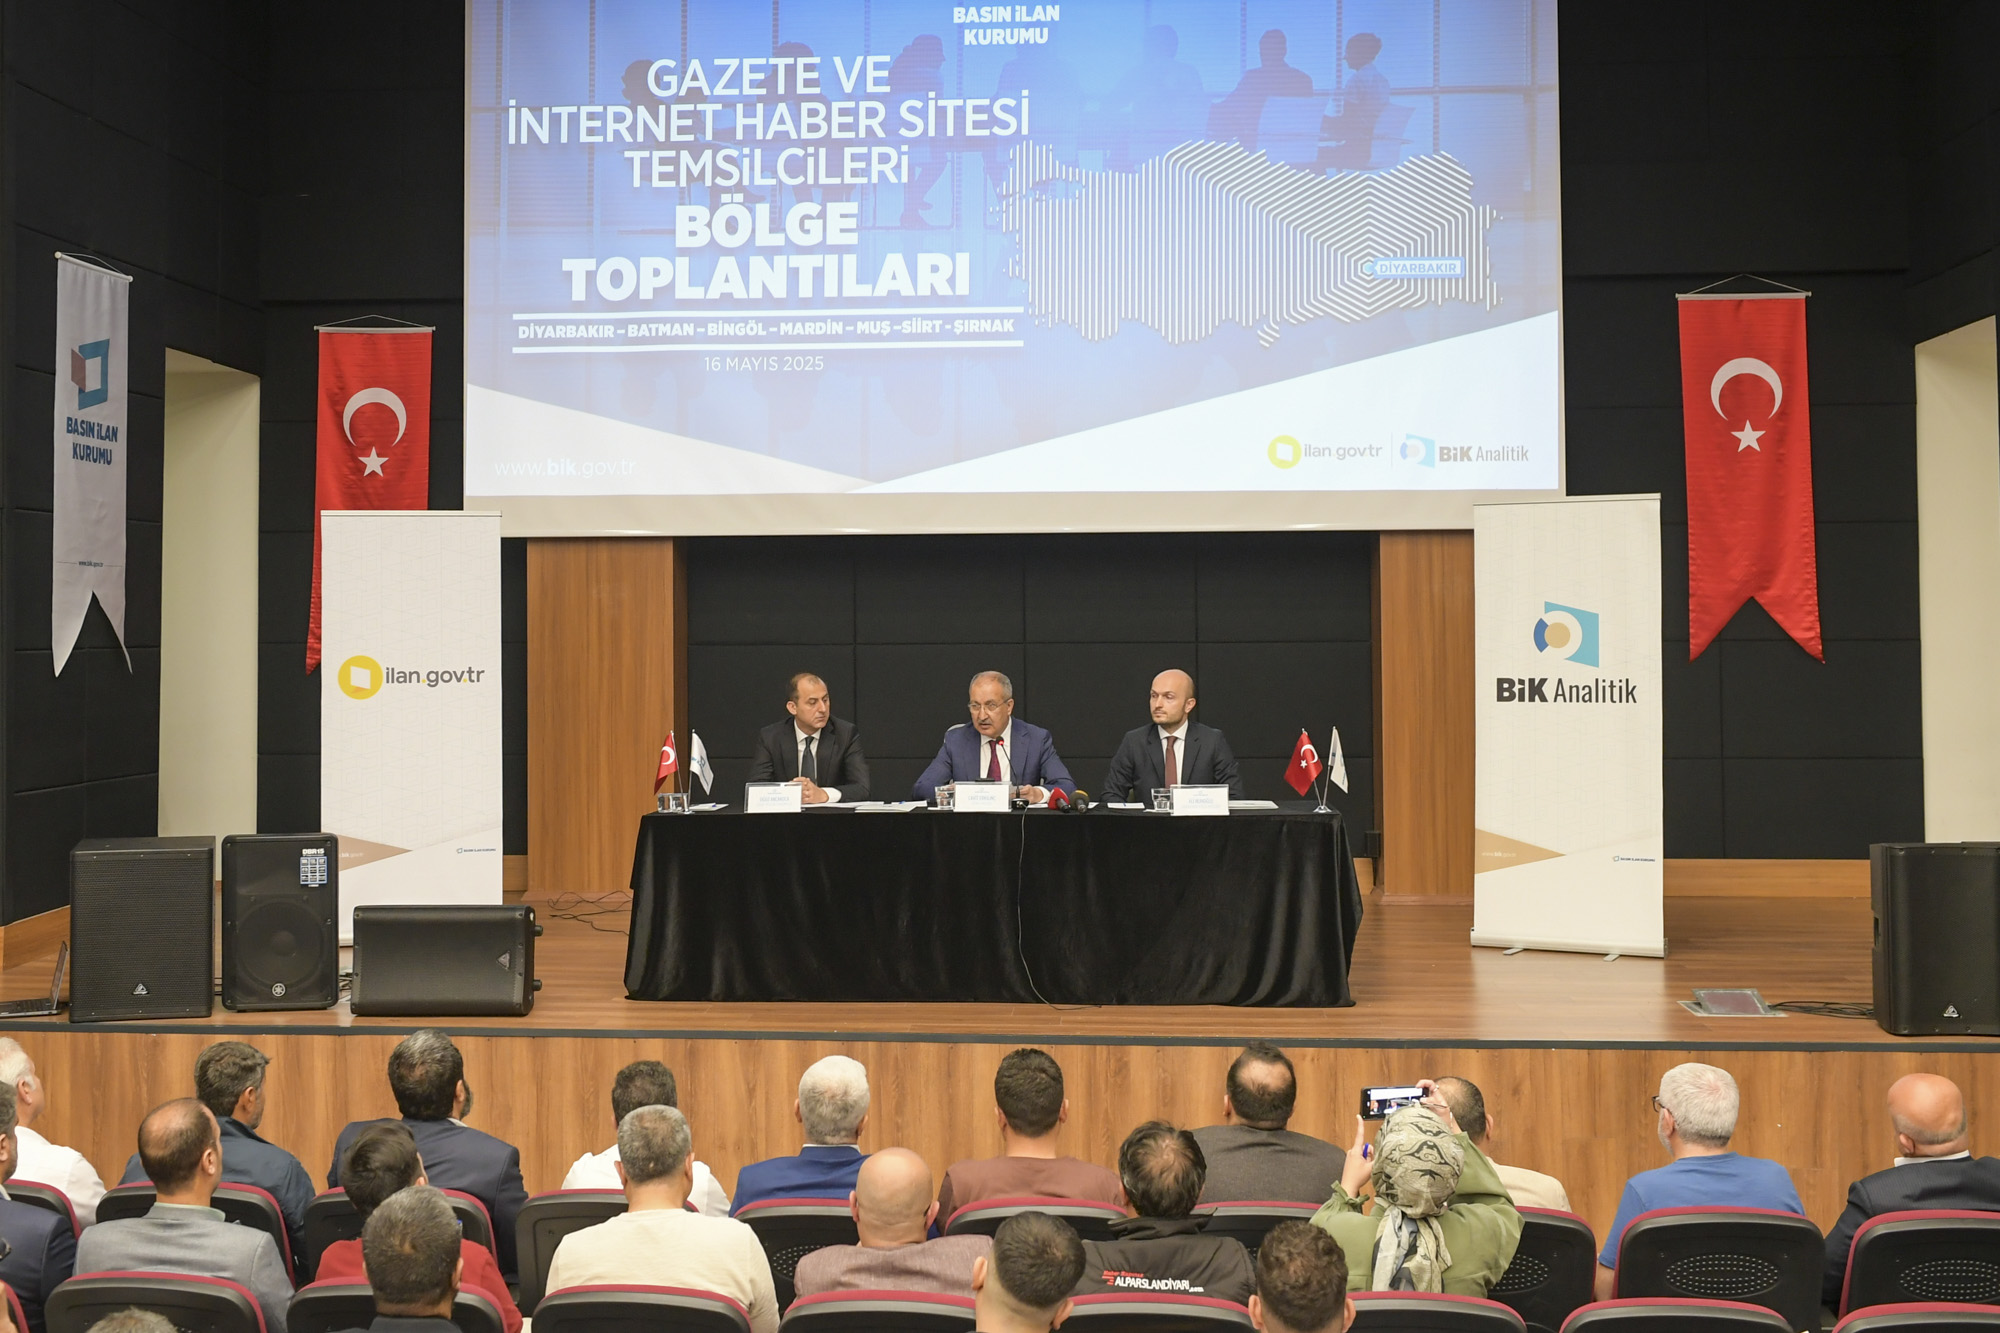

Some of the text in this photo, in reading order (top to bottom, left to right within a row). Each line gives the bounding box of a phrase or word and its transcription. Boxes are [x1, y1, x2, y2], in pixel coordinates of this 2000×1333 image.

[953, 6, 1012, 23] BASIN
[964, 27, 1049, 45] KURUMU
[647, 55, 891, 97] GAZETE VE
[508, 89, 1029, 144] İNTERNET HABER SİTESİ
[675, 193, 859, 248] BÖLGE
[562, 252, 970, 301] TOPLANTILARI
[1380, 261, 1457, 273] DİYARBAKIR
[518, 323, 614, 339] DİYARBAKIR
[627, 323, 694, 338] BATMAN
[707, 320, 767, 336] BİNGÖL
[780, 319, 843, 335] MARDİN
[857, 320, 891, 336] MUŞ
[953, 318, 1015, 335] ŞIRNAK
[704, 355, 824, 372] 16 MAYIS 2025
[66, 416, 95, 439] BASIN
[72, 442, 112, 466] KURUMU
[1476, 445, 1529, 462] Analitik
[494, 458, 637, 479] www.bik.gov.tr
[385, 666, 485, 688] ilan.gov.tr
[1553, 678, 1637, 703] Analitik
